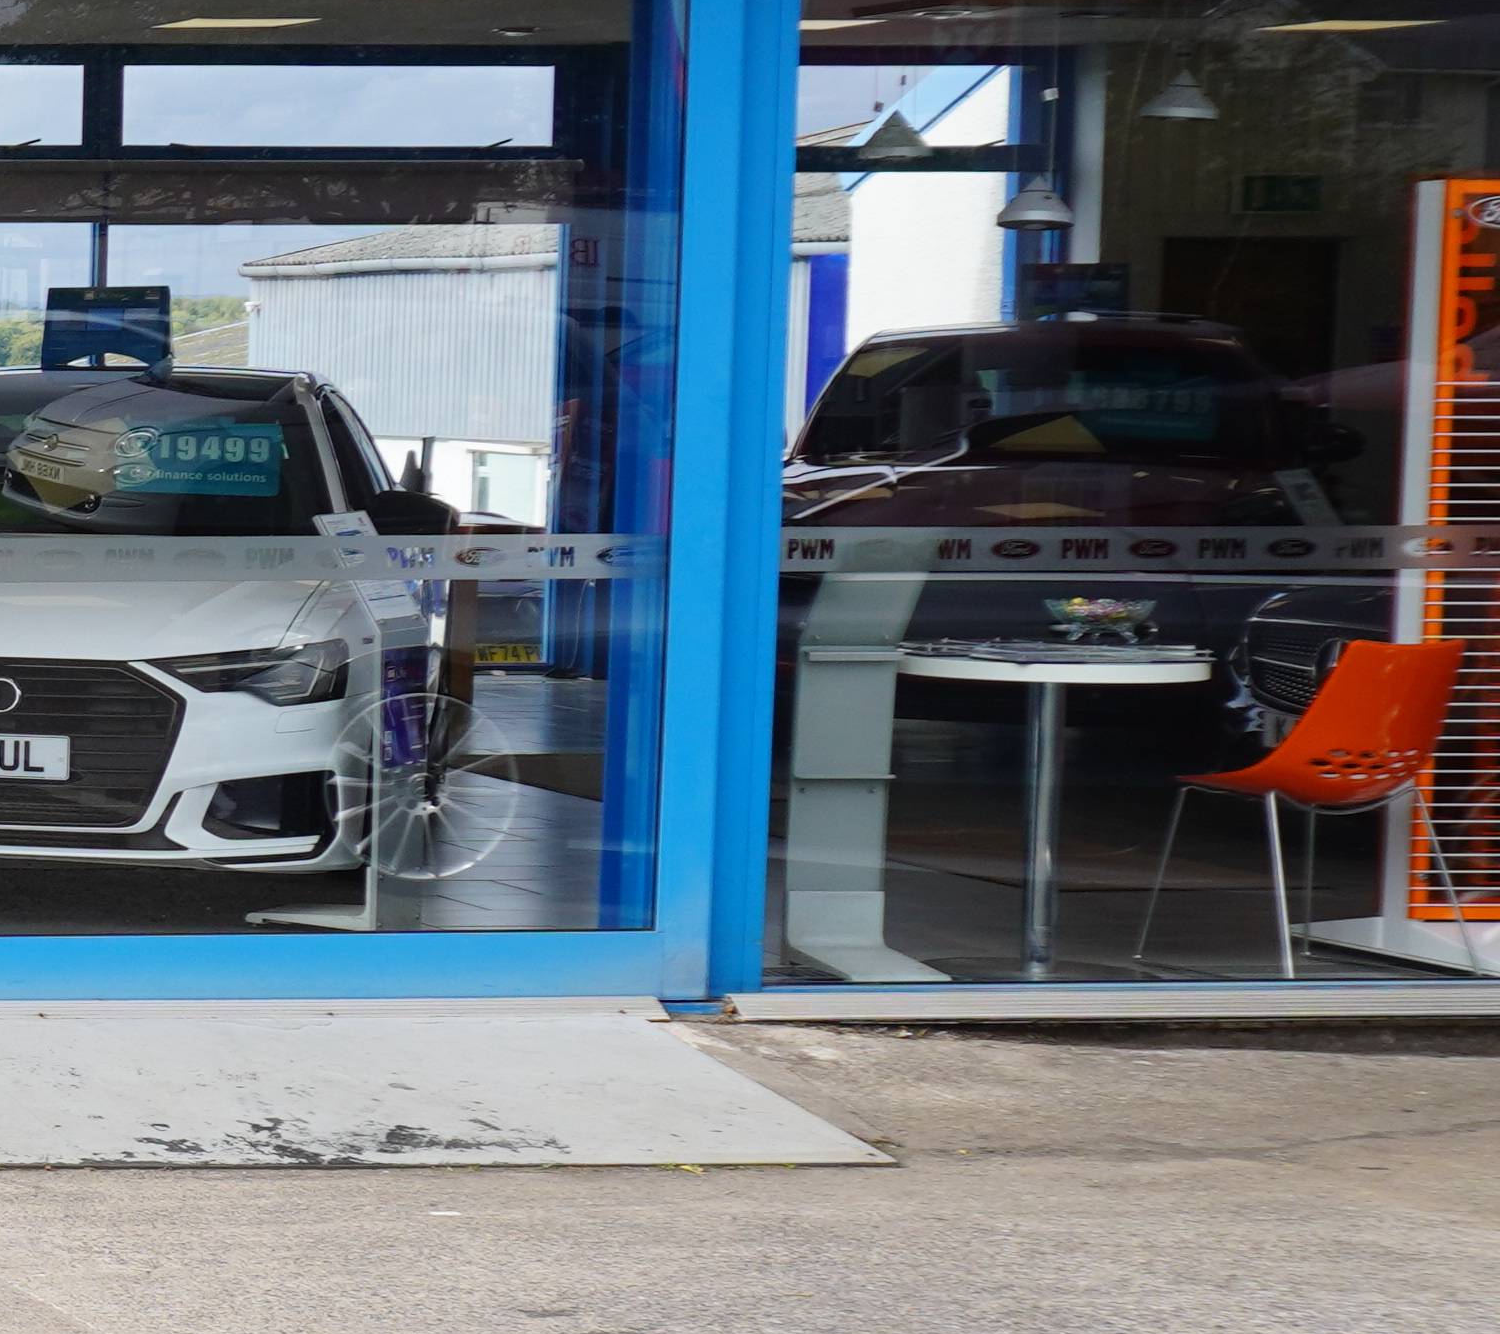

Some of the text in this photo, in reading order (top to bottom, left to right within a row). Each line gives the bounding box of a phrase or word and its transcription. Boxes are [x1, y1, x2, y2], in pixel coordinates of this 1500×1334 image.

[207, 470, 267, 483] solutions
[787, 538, 835, 560] PWM
[936, 538, 972, 560] WM
[1060, 538, 1109, 560] PWM
